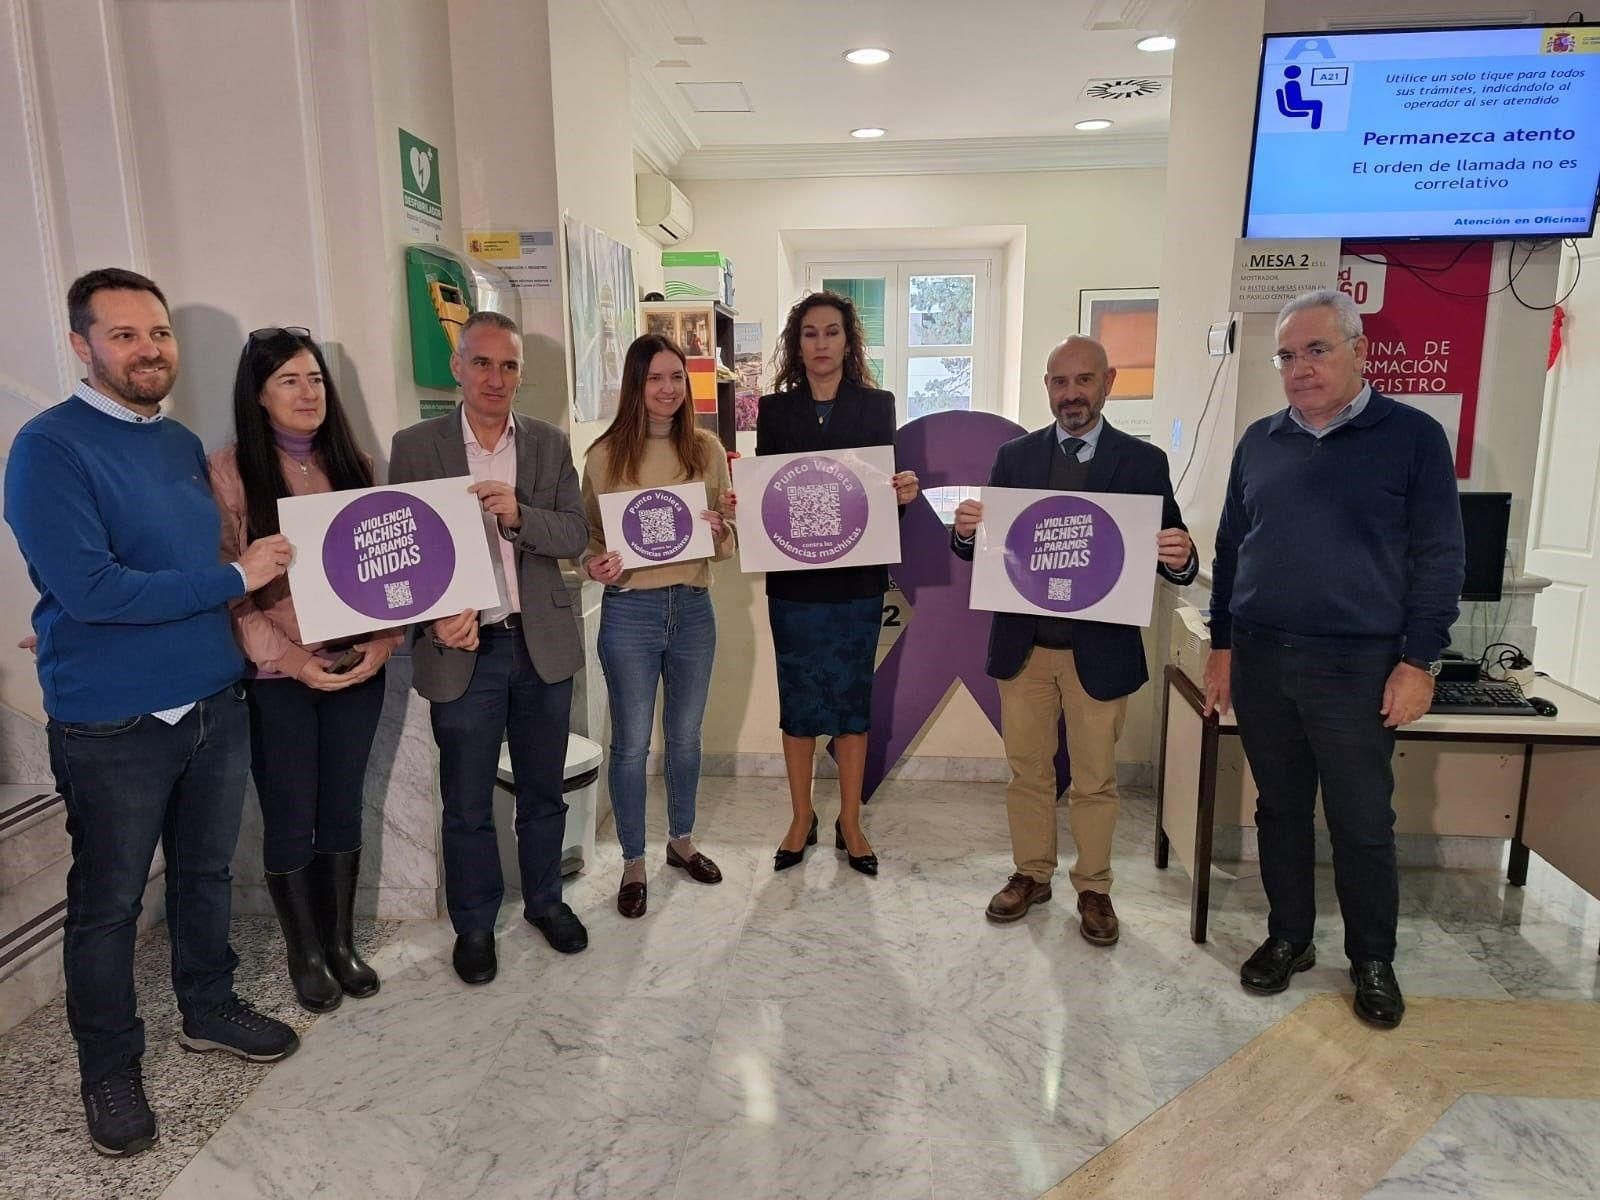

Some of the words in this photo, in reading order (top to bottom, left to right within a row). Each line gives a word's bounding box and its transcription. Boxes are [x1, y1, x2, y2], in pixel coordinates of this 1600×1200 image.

[1386, 72, 1427, 83] Utilice
[1431, 74, 1447, 82] un
[1450, 72, 1476, 82] solo
[1480, 71, 1514, 84] tique
[1516, 70, 1546, 82] para
[1550, 68, 1586, 78] todos
[1396, 88, 1415, 96] sus
[1419, 84, 1476, 96] trámites,
[1482, 82, 1554, 93] indicándolo
[1558, 82, 1570, 90] al
[1404, 100, 1460, 111] operador
[1464, 99, 1476, 108] al
[1480, 98, 1498, 106] ser
[1503, 96, 1559, 106] atendido
[1364, 130, 1495, 146] Permanezca
[1503, 128, 1576, 142] atento
[1352, 162, 1367, 174] El
[1374, 160, 1422, 173] orden
[1429, 160, 1450, 172] de
[1456, 158, 1525, 171] llamada
[1532, 158, 1553, 169] no
[1559, 158, 1578, 168] es
[1414, 176, 1508, 190] correlativo
[1454, 216, 1510, 226] Atención
[1534, 216, 1586, 224] Oficinas
[1250, 254, 1295, 267] MESA
[1300, 254, 1309, 267] 2
[1424, 340, 1451, 355] DE
[1362, 356, 1448, 374] RMACIÓN
[1372, 378, 1446, 392] GISTRO
[773, 464, 809, 492] Punto
[814, 460, 853, 492] Violeta
[629, 495, 652, 514] Punto
[655, 492, 682, 512] Violeta
[354, 527, 361, 535] LA
[361, 507, 412, 532] VIOLENCIA
[1044, 514, 1092, 528] VIOLENCIA
[354, 518, 417, 550] MACHISTA
[1034, 524, 1093, 542] MACHISTA
[359, 553, 368, 561] LA
[368, 534, 414, 558] PARAMOS
[631, 541, 661, 556] violencias
[773, 532, 817, 558] violencias
[819, 528, 861, 558] machistas
[1044, 539, 1088, 552] PARAMOS
[357, 545, 421, 583] UNIDAS
[1030, 549, 1091, 571] UNIDAS
[883, 605, 900, 626] 2
